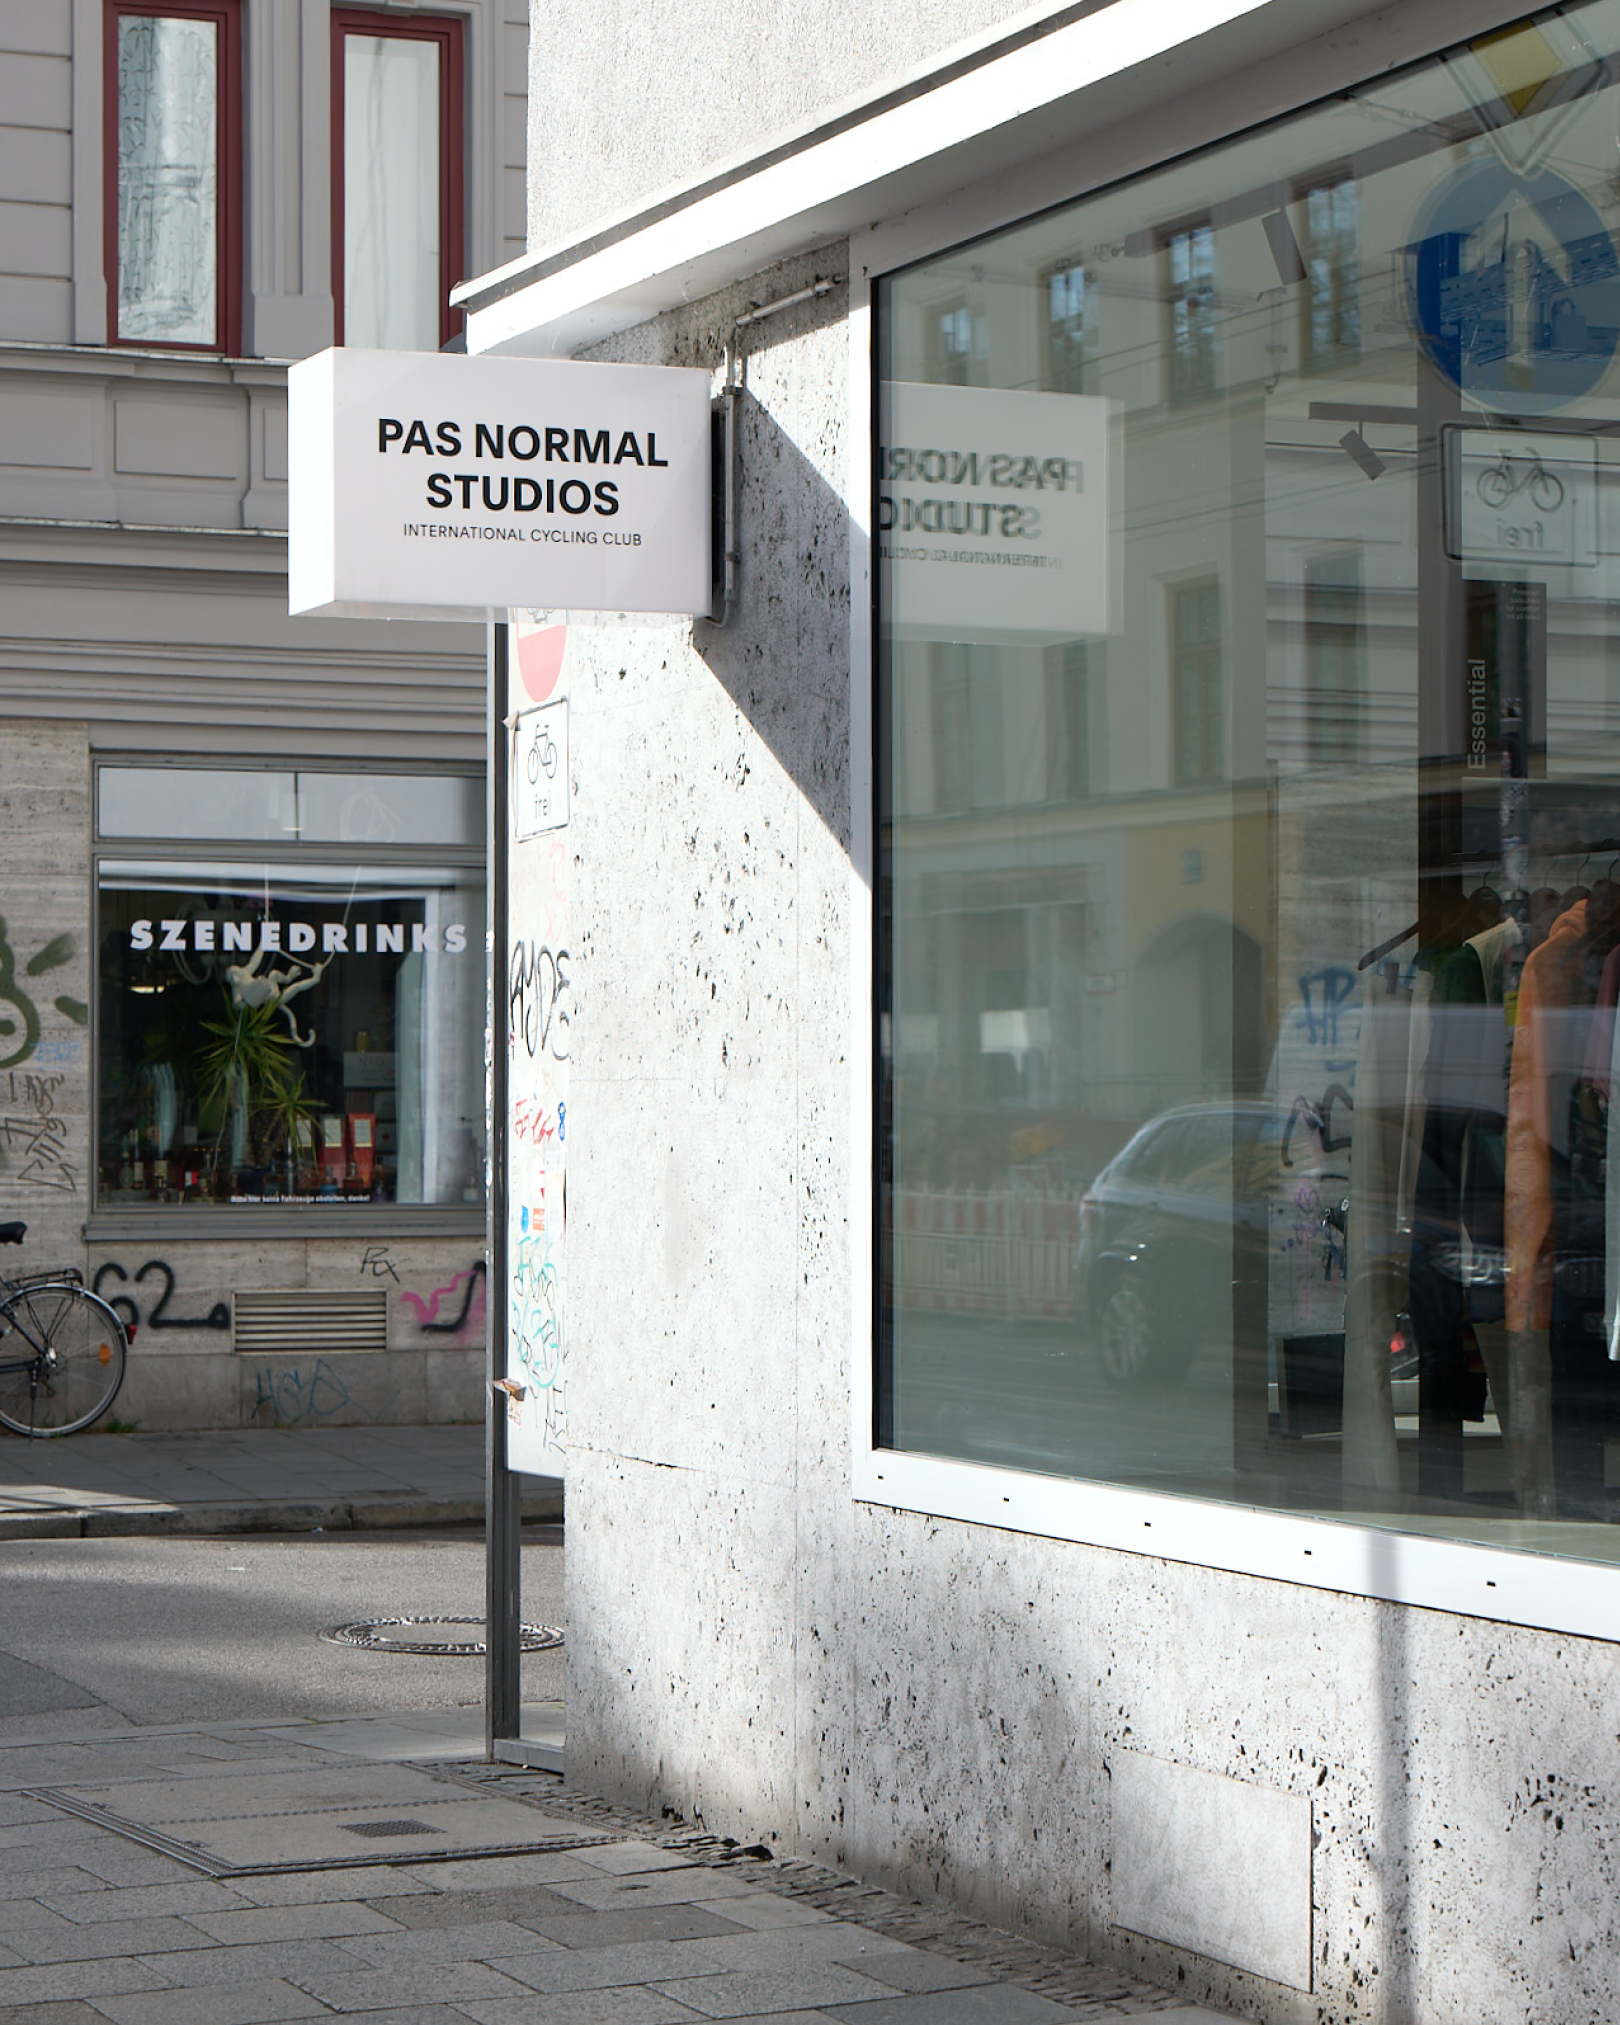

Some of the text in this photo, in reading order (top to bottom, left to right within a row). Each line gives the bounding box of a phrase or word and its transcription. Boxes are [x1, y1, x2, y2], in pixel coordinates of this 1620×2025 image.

[378, 418, 668, 467] PAS NORMAL
[426, 472, 619, 516] STUDIOS
[403, 523, 642, 547] INTERNATIONAL CYCLING CLUB
[1467, 658, 1486, 770] Essential
[130, 919, 468, 953] SZENEDRINKS
